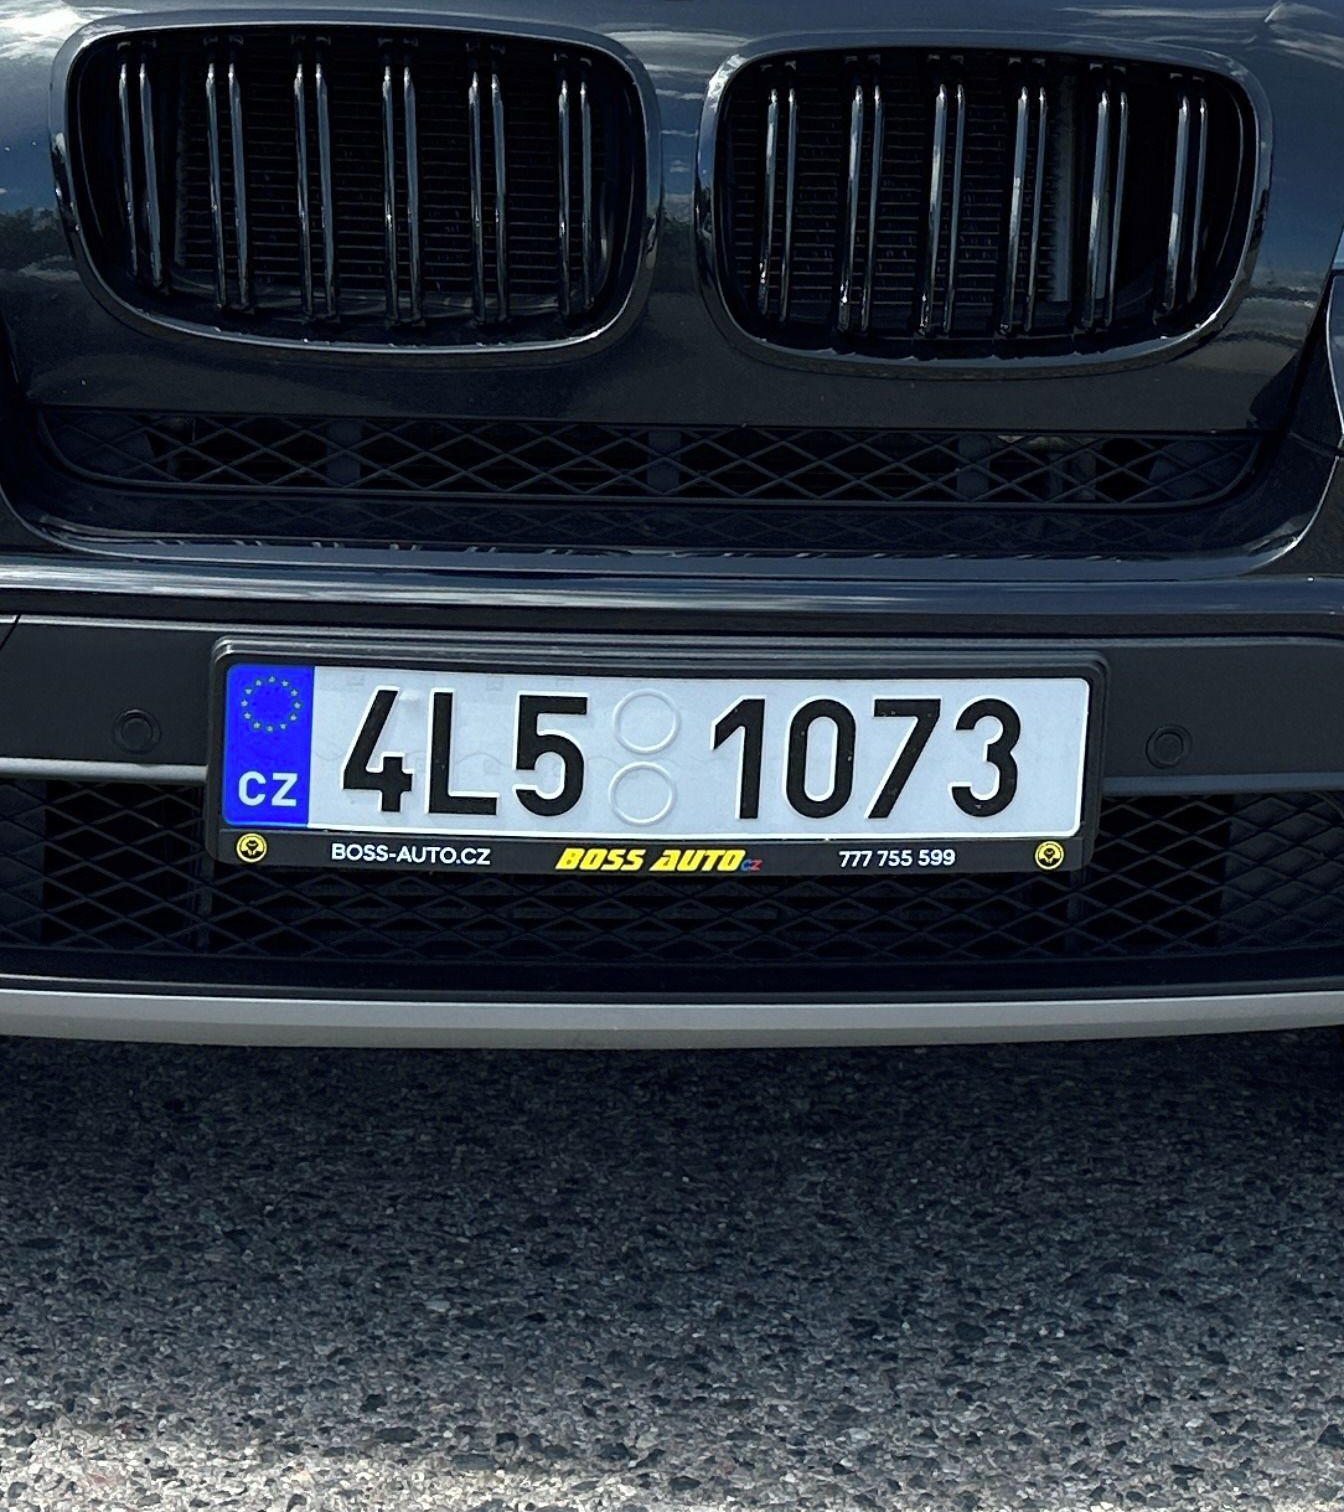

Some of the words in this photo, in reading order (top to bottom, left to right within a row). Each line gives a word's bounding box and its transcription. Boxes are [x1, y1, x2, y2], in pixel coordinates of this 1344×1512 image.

[341, 687, 588, 817] 4L5
[711, 696, 1022, 819] 1073
[238, 771, 298, 807] CZ
[331, 842, 491, 866] BOSS-AUTO.CZ
[555, 848, 647, 872] BOSS
[650, 848, 746, 872] AUTO
[839, 850, 873, 868] 777
[877, 849, 913, 868] 755
[918, 848, 956, 867] 599
